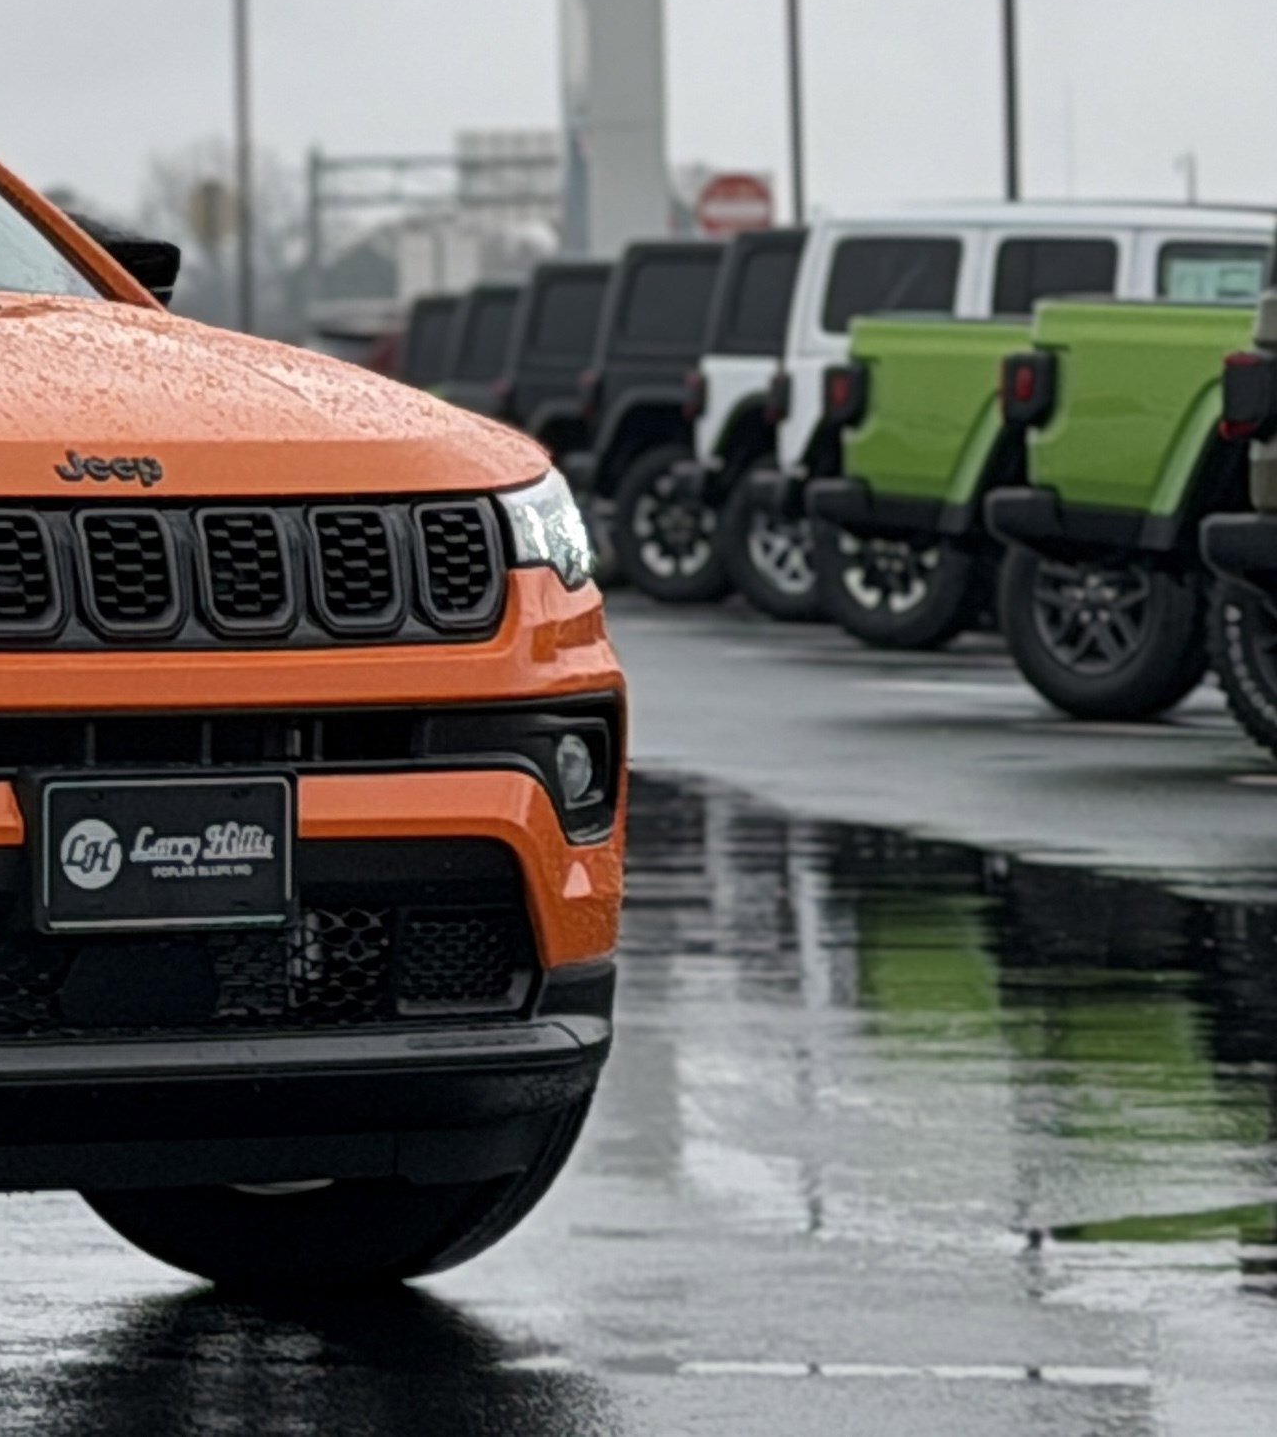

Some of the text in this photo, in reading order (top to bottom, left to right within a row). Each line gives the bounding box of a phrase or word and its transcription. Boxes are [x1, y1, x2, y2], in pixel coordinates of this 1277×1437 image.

[52, 448, 163, 488] Jeep
[129, 820, 274, 865] Larry Hillis
